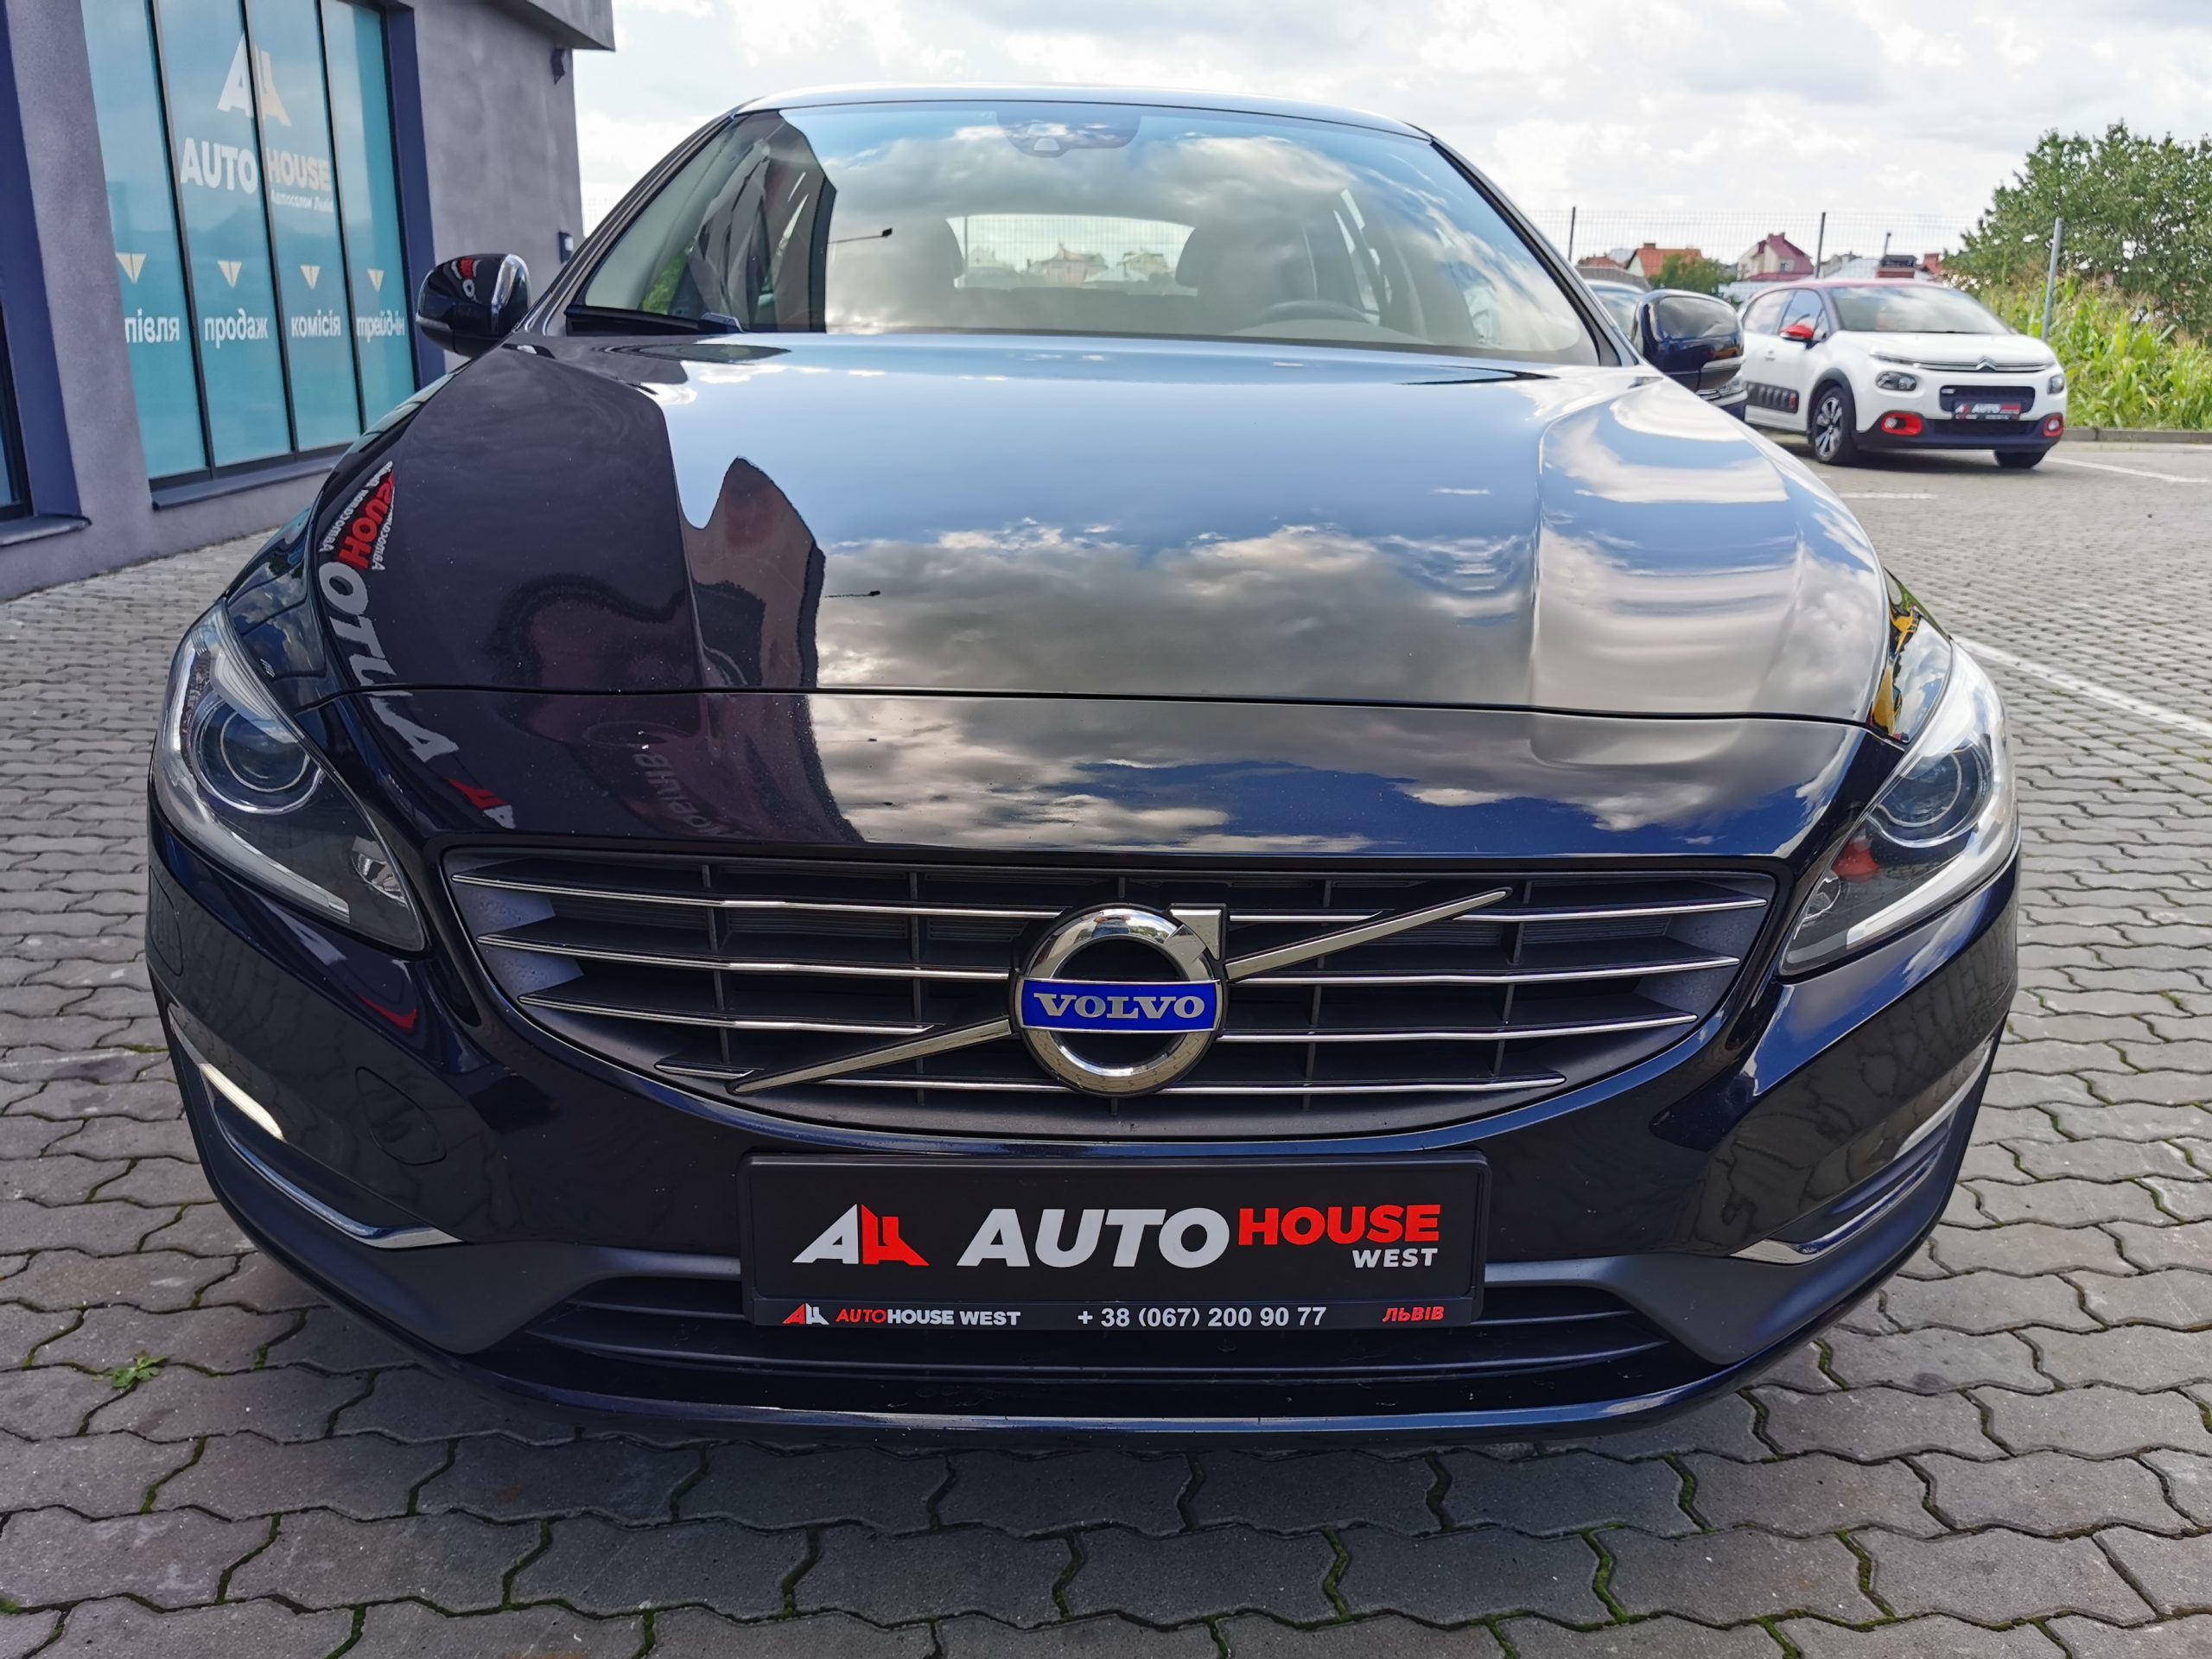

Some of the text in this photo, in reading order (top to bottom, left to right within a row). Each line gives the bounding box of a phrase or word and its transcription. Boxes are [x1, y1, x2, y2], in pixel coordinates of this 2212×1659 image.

[180, 137, 332, 194] AUTO HOUSE
[124, 308, 180, 343] півля
[204, 308, 269, 348] продаж
[291, 308, 341, 338] комісія
[1033, 992, 1205, 1019] VOLVO
[956, 1207, 1230, 1268] AUTO
[1238, 1205, 1440, 1245] HOUSE
[1351, 1248, 1439, 1268] WEST
[836, 1308, 955, 1325] AUTOHOUSE
[959, 1311, 1021, 1325] WEST
[1100, 1307, 1130, 1326] 38
[1138, 1306, 1200, 1326] (067)
[1208, 1306, 1252, 1327] 200
[1260, 1306, 1289, 1326] 90
[1297, 1306, 1327, 1326] 77
[1382, 1306, 1444, 1322] ЛЬВІВ
